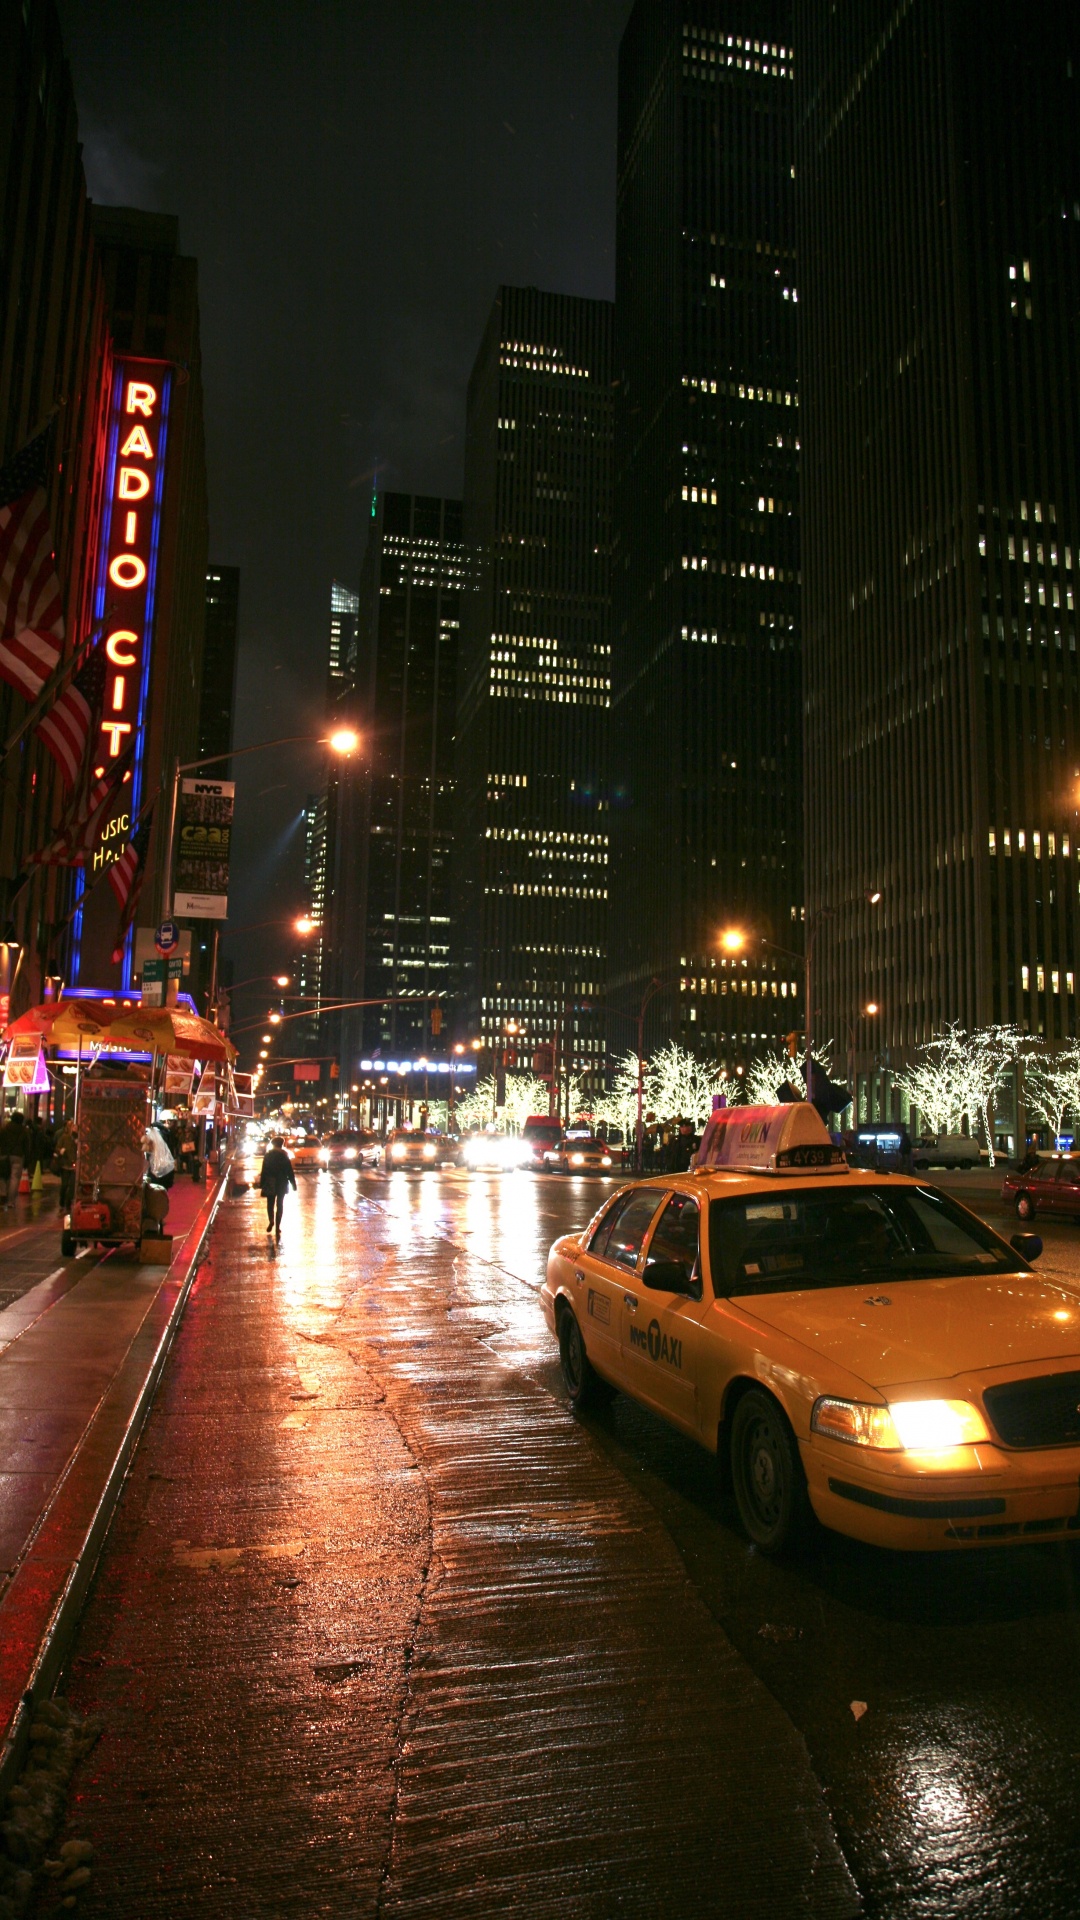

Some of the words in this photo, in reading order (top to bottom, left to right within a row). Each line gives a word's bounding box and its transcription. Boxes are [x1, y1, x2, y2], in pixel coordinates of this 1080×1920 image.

[108, 381, 158, 590] RADIO
[93, 628, 140, 781] CIT
[194, 783, 223, 795] NYC
[101, 813, 130, 841] USIC
[181, 825, 221, 843] caa
[740, 1121, 772, 1143] OWN
[793, 1150, 825, 1165] 4Y39
